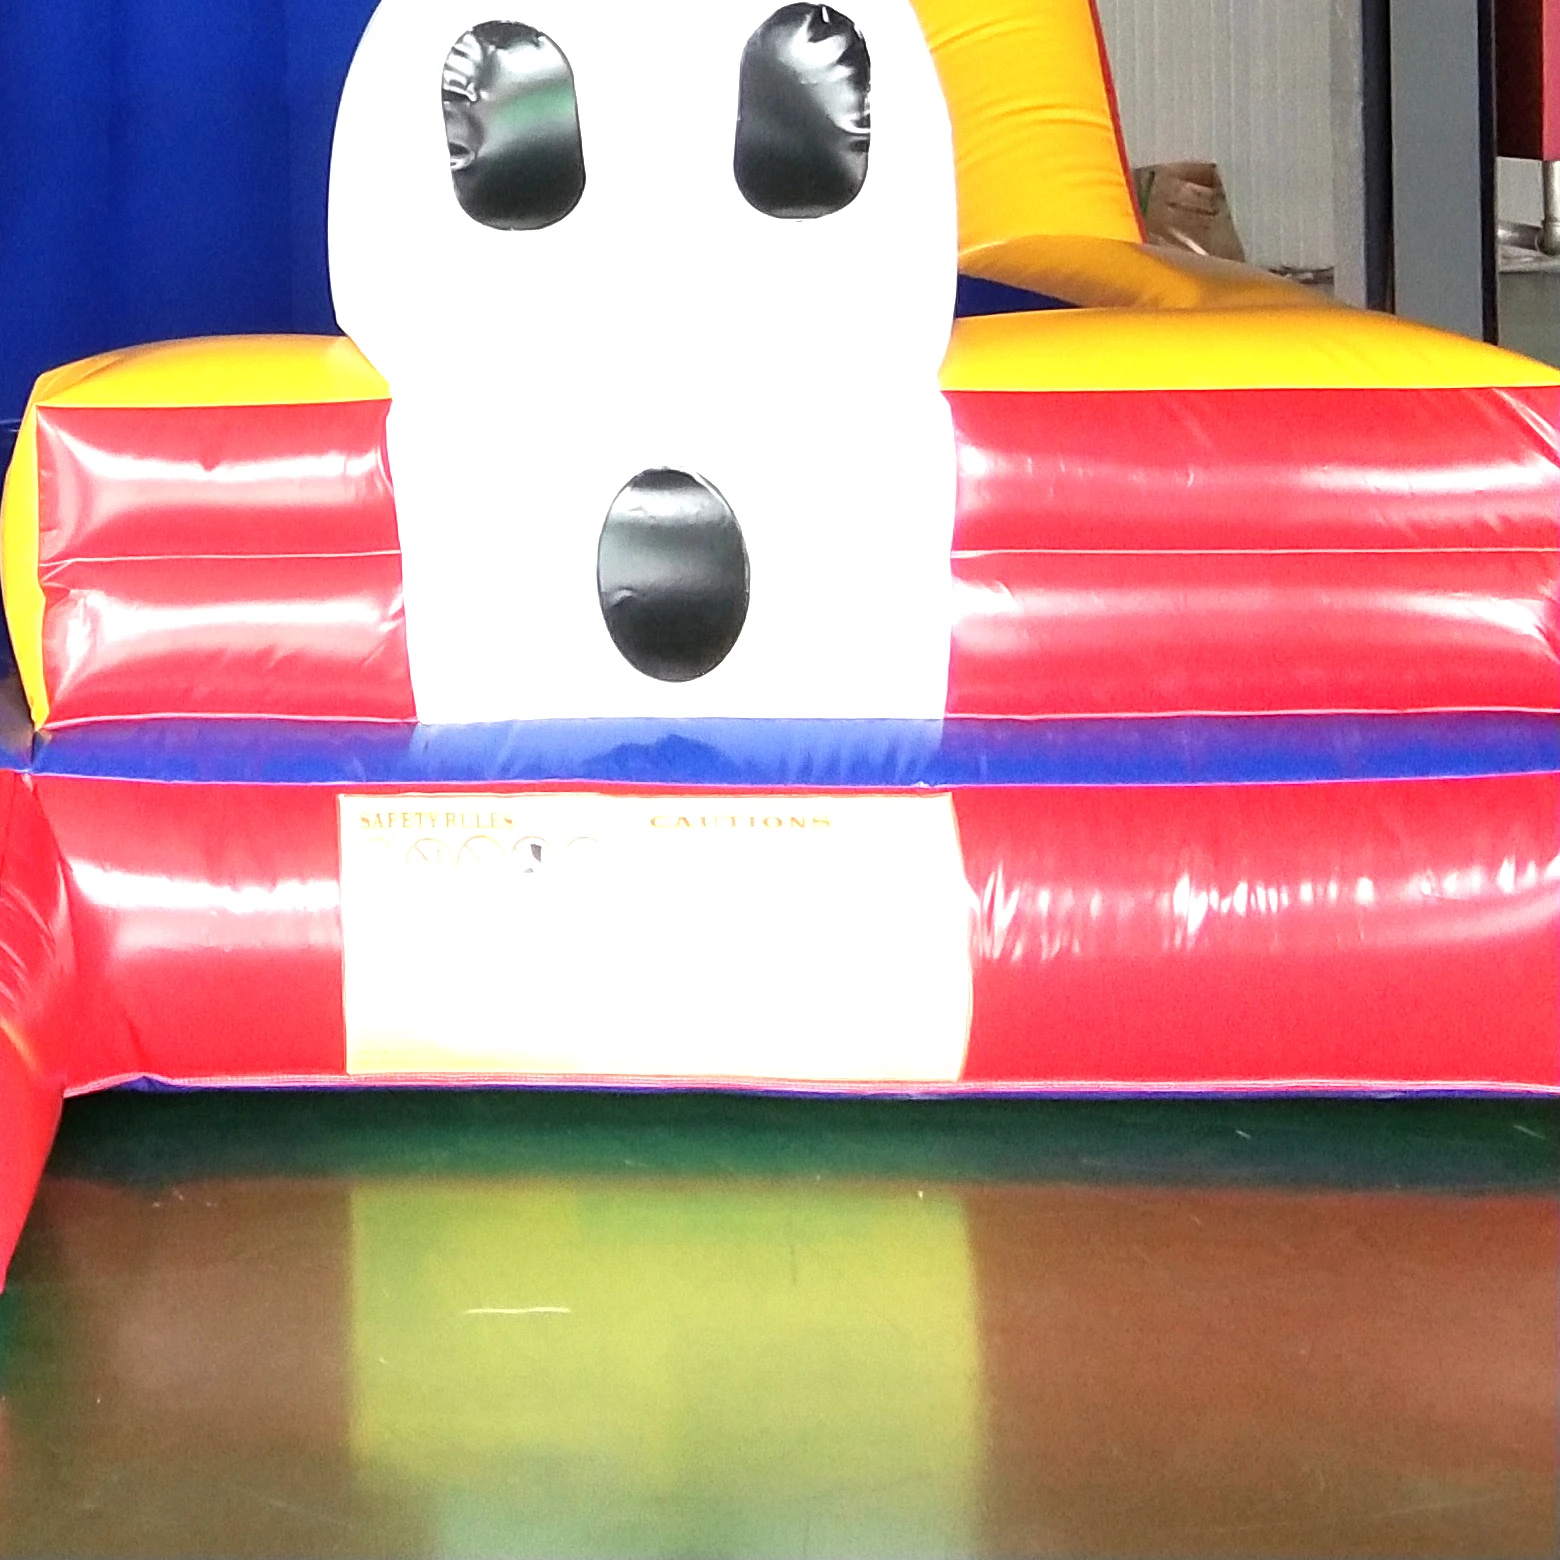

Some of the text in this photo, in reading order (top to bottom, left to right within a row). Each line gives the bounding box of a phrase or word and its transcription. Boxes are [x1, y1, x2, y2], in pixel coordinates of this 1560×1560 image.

[359, 811, 515, 830] SAFETY RULES
[649, 814, 832, 830] CAUTIONS
